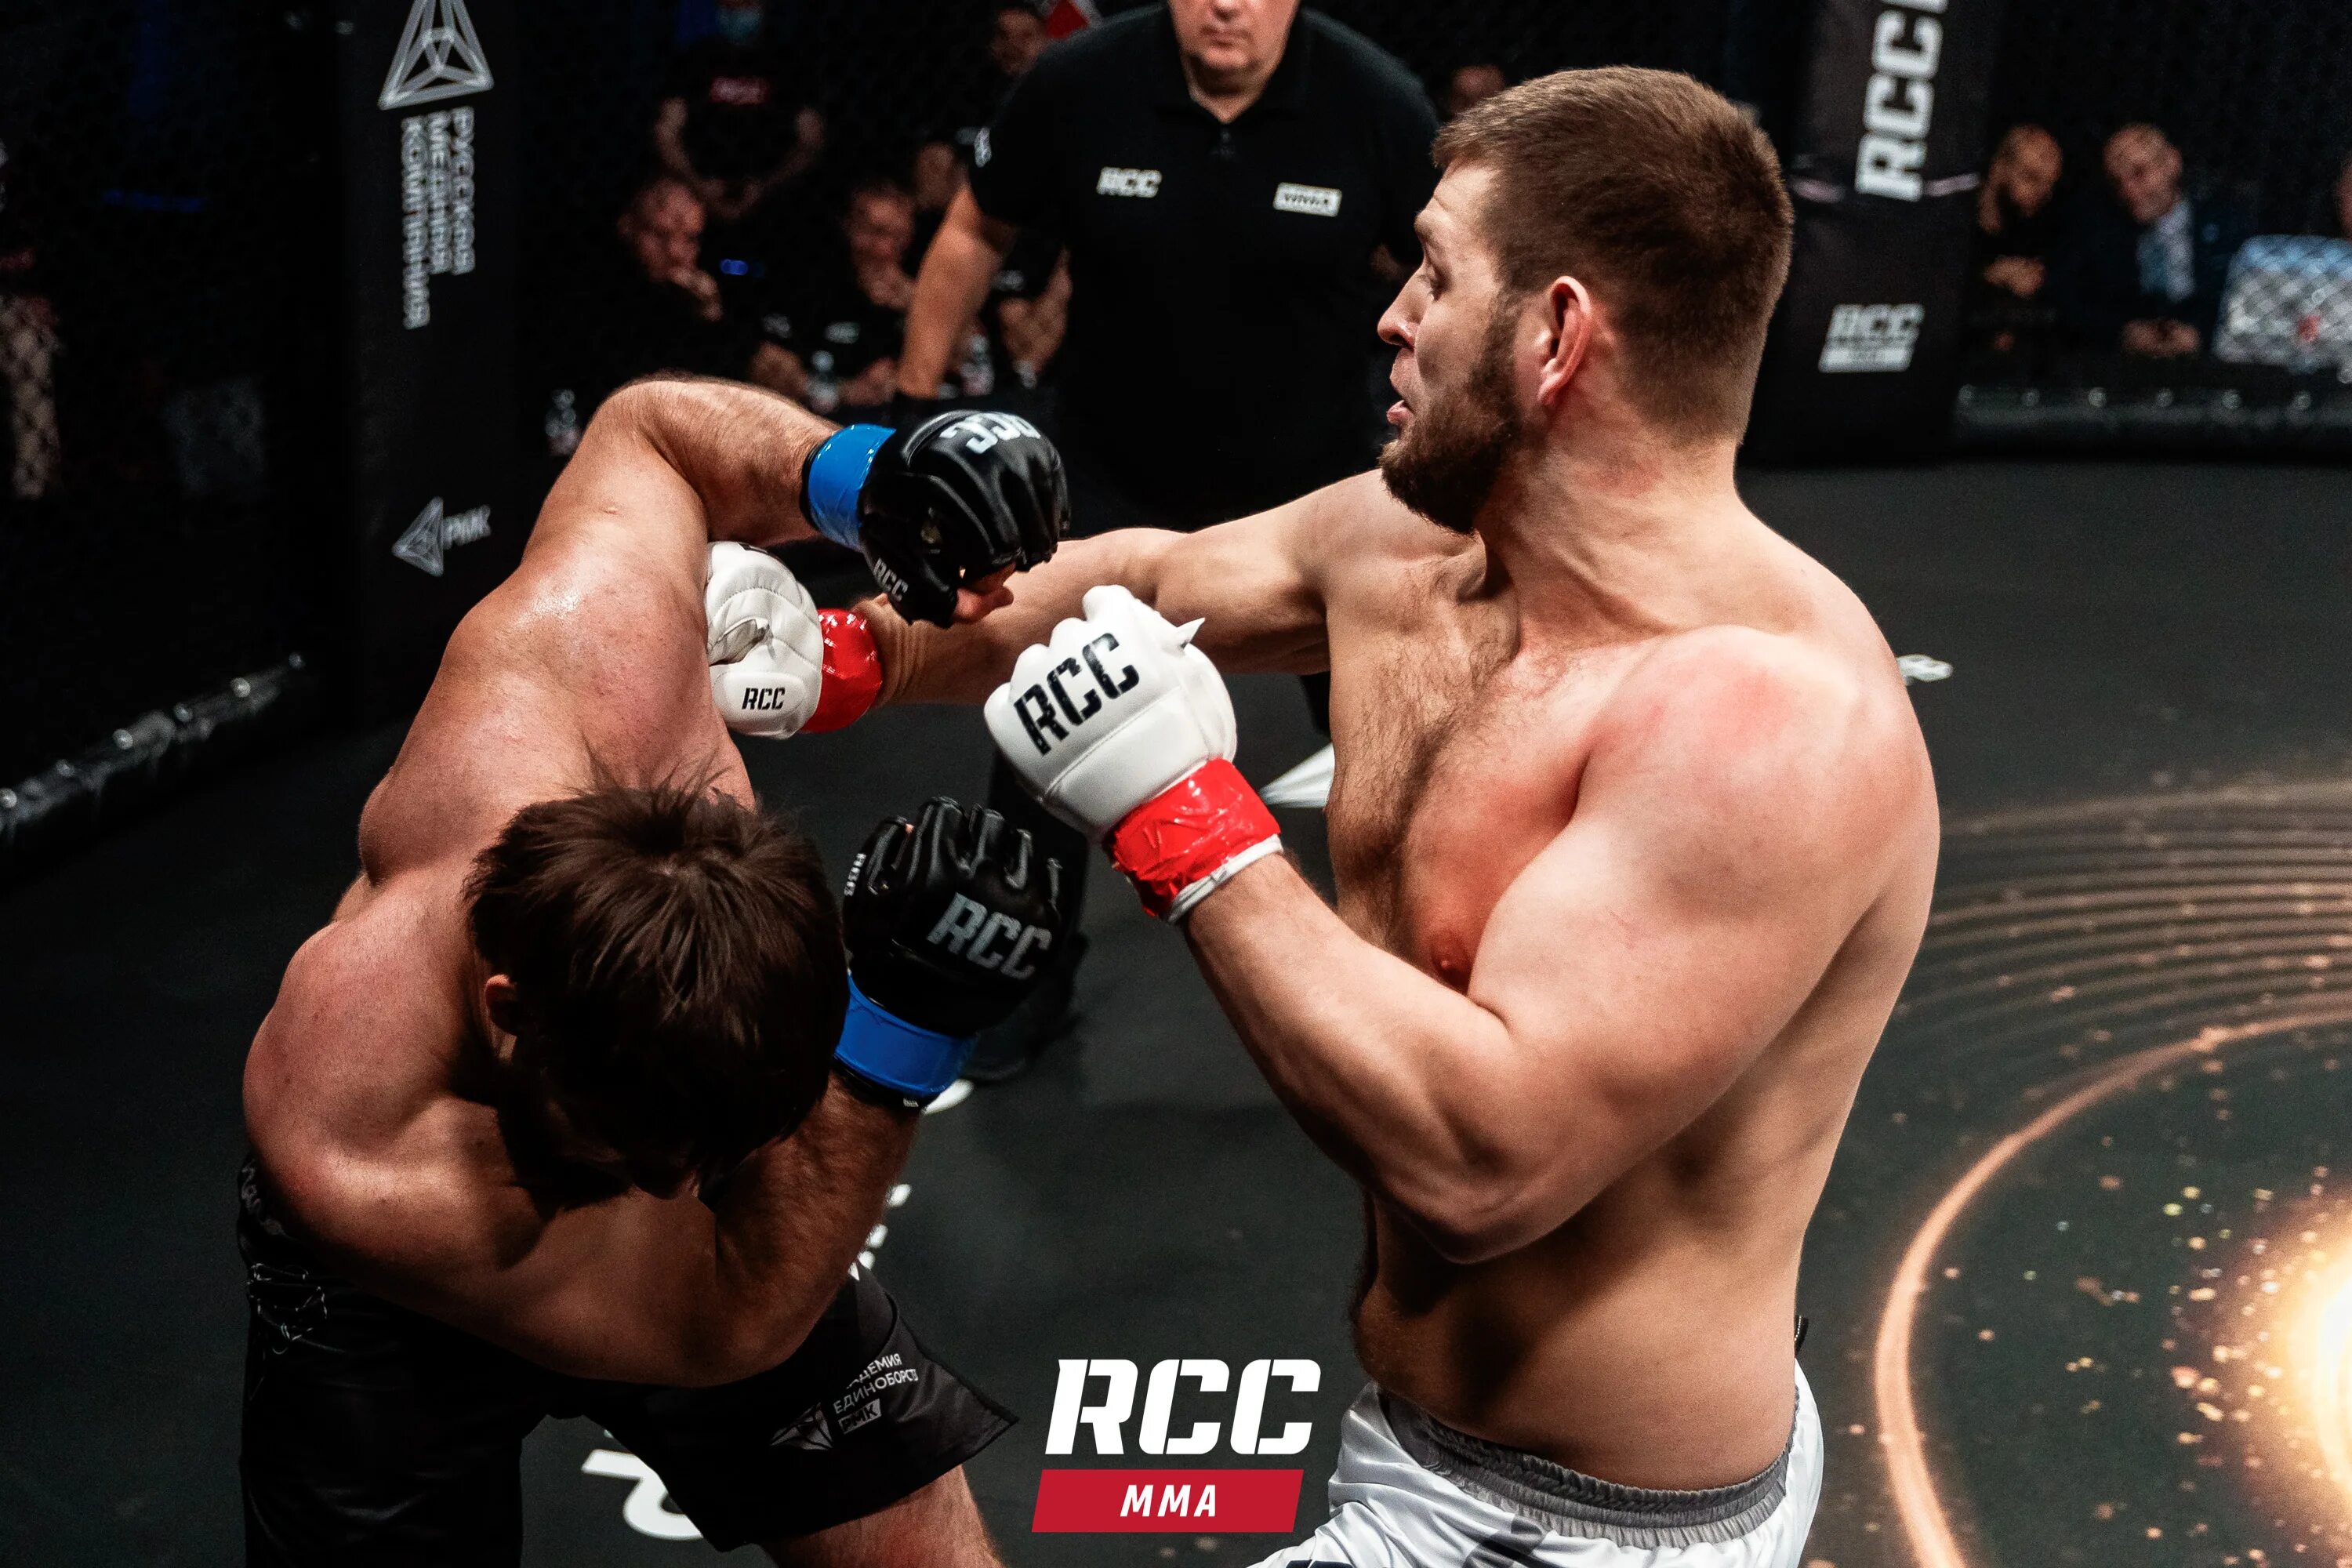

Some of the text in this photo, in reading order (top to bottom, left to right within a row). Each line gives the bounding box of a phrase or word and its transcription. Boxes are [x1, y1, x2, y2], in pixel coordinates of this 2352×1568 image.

[1854, 0, 1948, 202] RCC
[873, 557, 909, 602] RCC
[742, 687, 786, 710] RCC
[1014, 633, 1140, 757] RCC
[927, 891, 1052, 979] RCC
